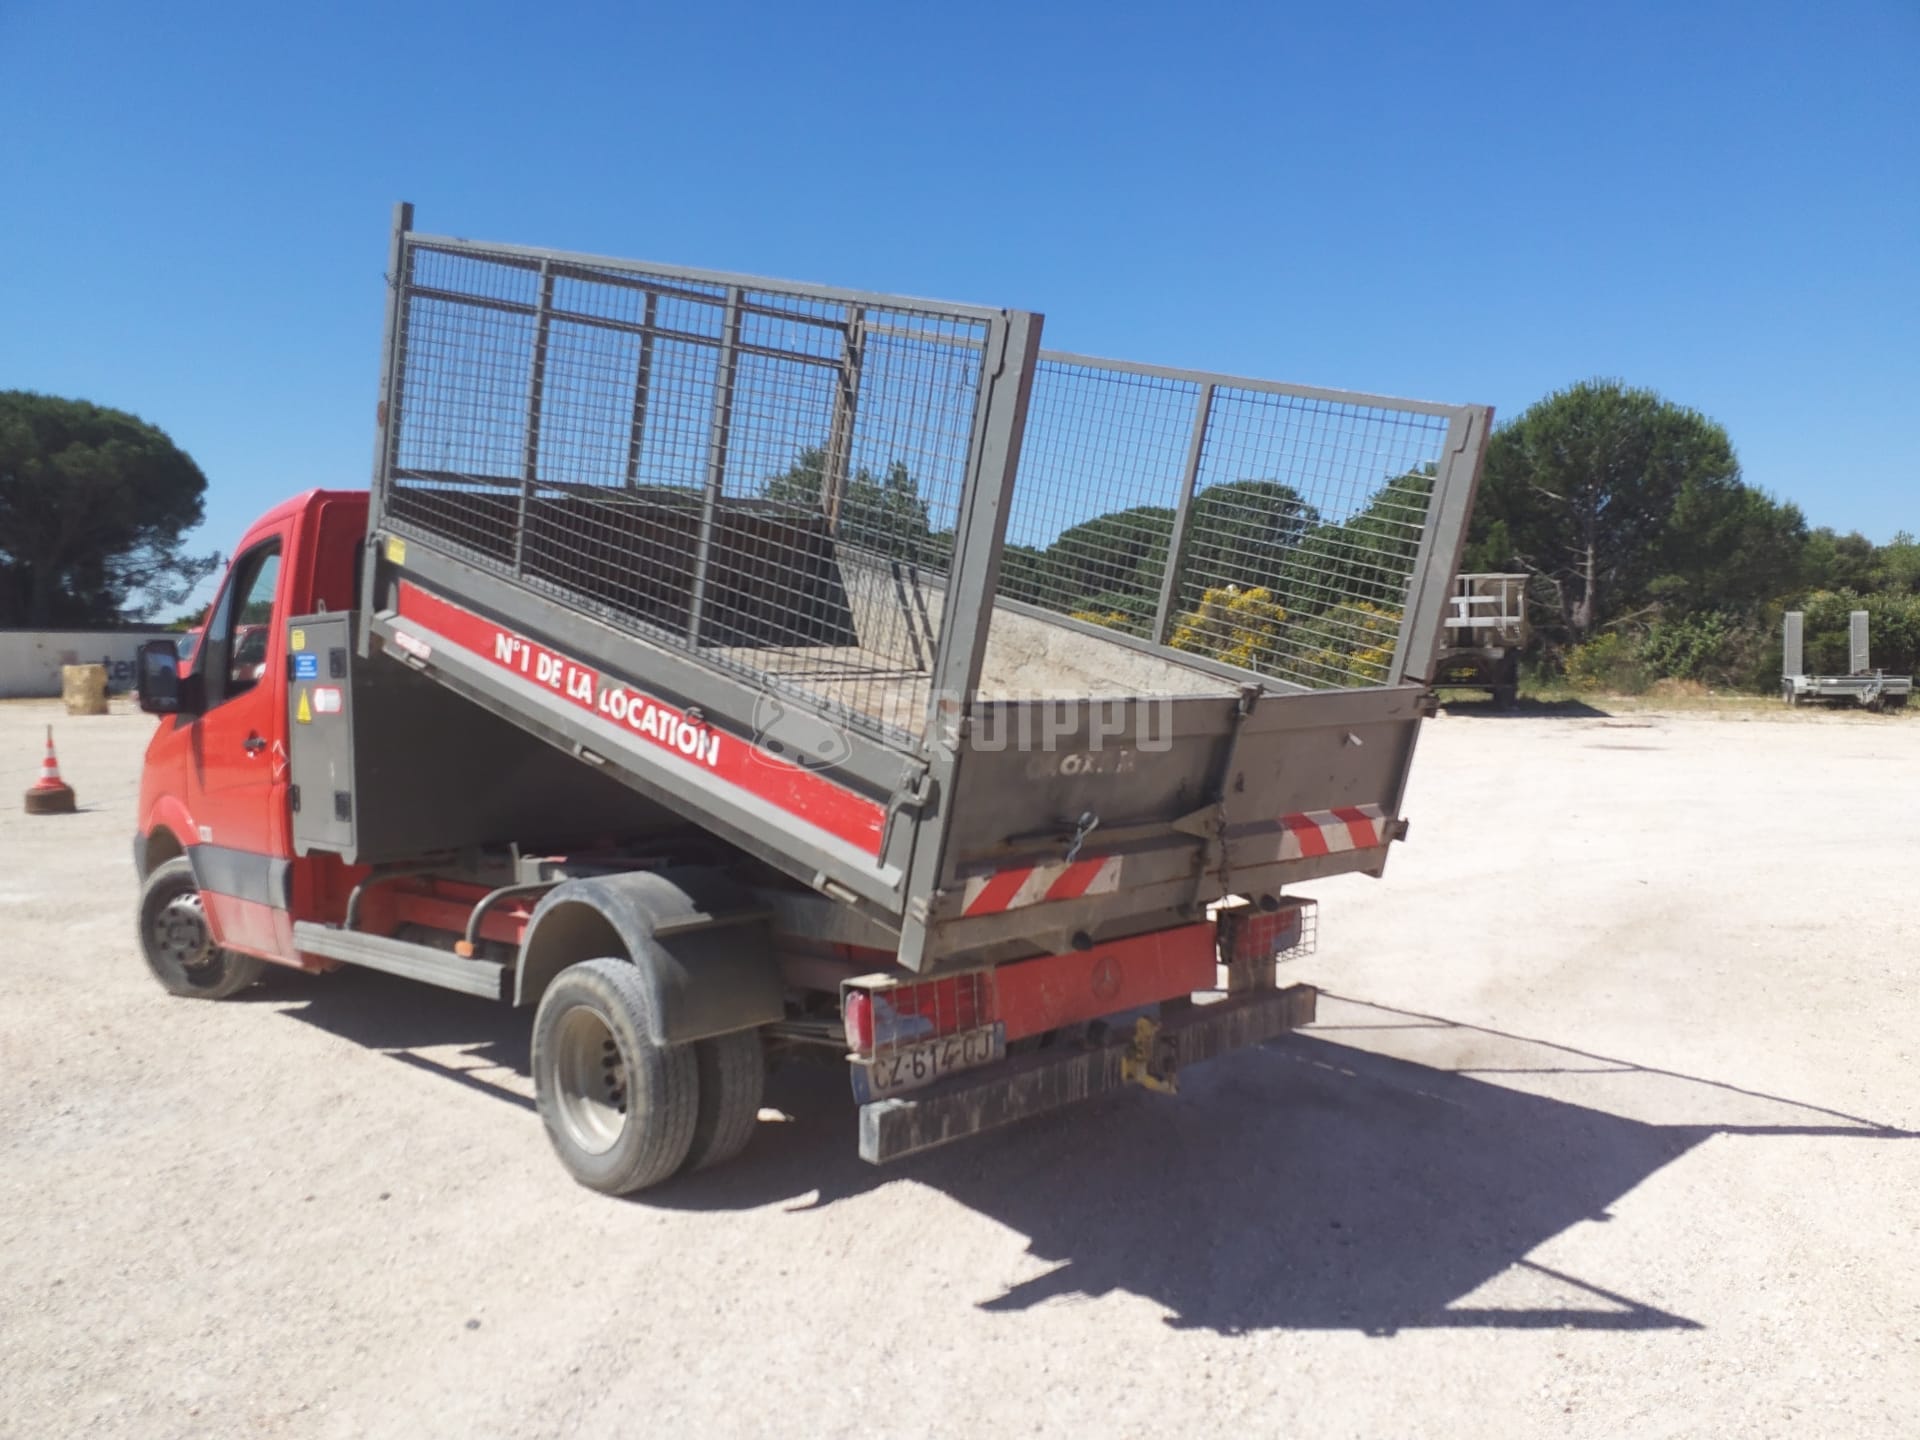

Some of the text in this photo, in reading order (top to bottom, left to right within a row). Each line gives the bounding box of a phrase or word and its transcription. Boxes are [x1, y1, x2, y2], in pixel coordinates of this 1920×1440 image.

[535, 652, 563, 689] DE
[566, 667, 593, 704] LA
[598, 687, 721, 767] LOCATION
